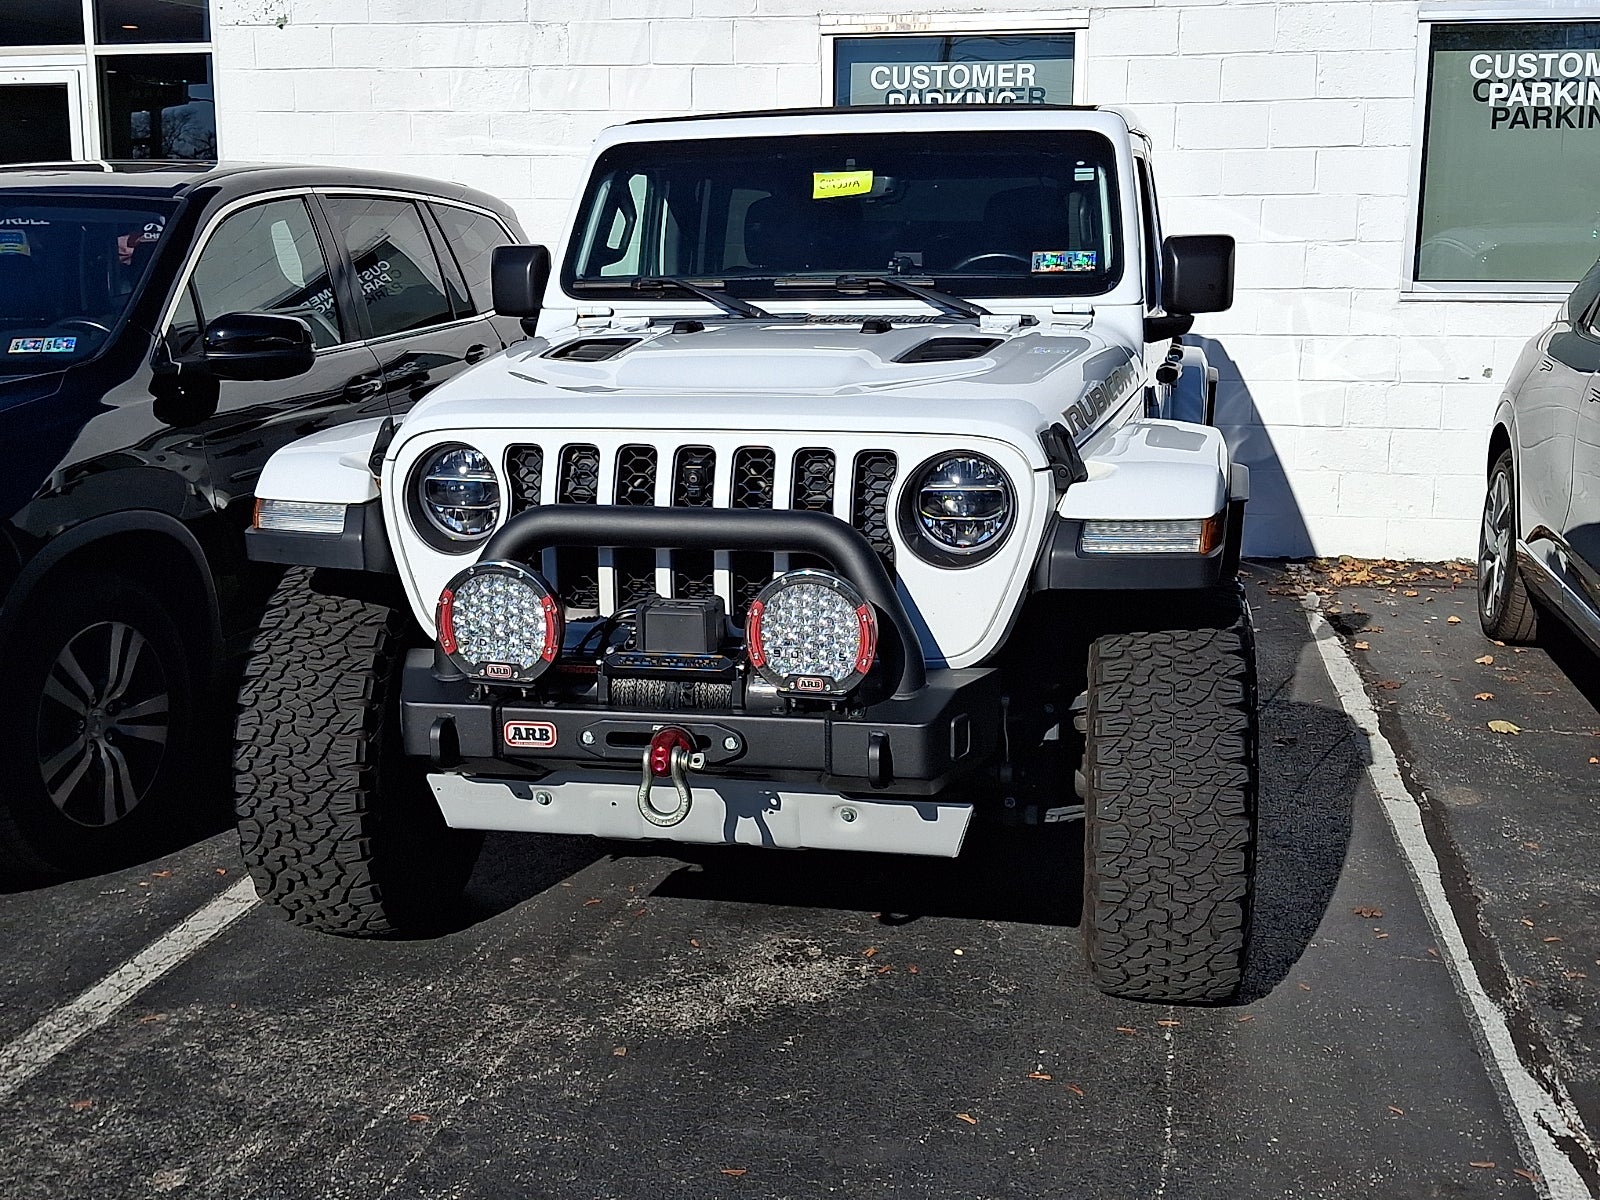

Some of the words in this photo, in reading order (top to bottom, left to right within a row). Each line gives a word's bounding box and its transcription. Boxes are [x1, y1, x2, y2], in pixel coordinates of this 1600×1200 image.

[1469, 52, 1600, 79] CUSTOM
[870, 63, 1036, 90] CUSTOMER
[1488, 81, 1600, 107] PARKIN
[489, 666, 509, 675] ARB
[800, 680, 821, 688] ARB
[511, 726, 551, 742] ARB
